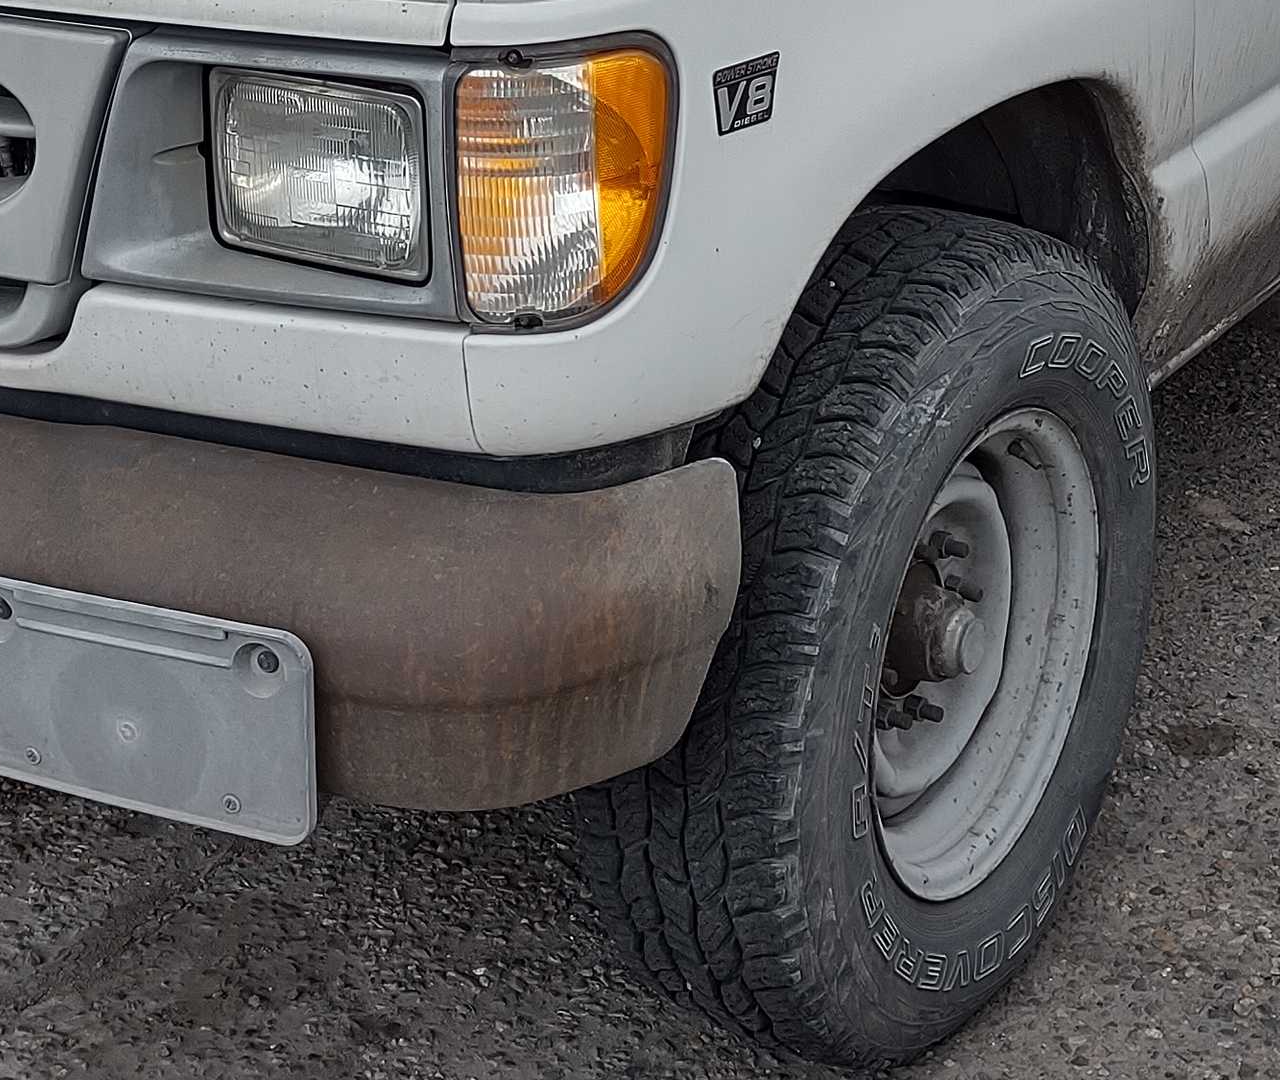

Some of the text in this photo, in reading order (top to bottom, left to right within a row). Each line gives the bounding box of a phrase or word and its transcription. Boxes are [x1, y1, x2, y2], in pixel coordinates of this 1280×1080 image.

[716, 54, 778, 82] POWER STROKE
[718, 75, 772, 131] V8
[734, 112, 769, 128] DIESEL
[1020, 332, 1151, 489] COOPER
[861, 805, 1088, 992] DISCOVERER
